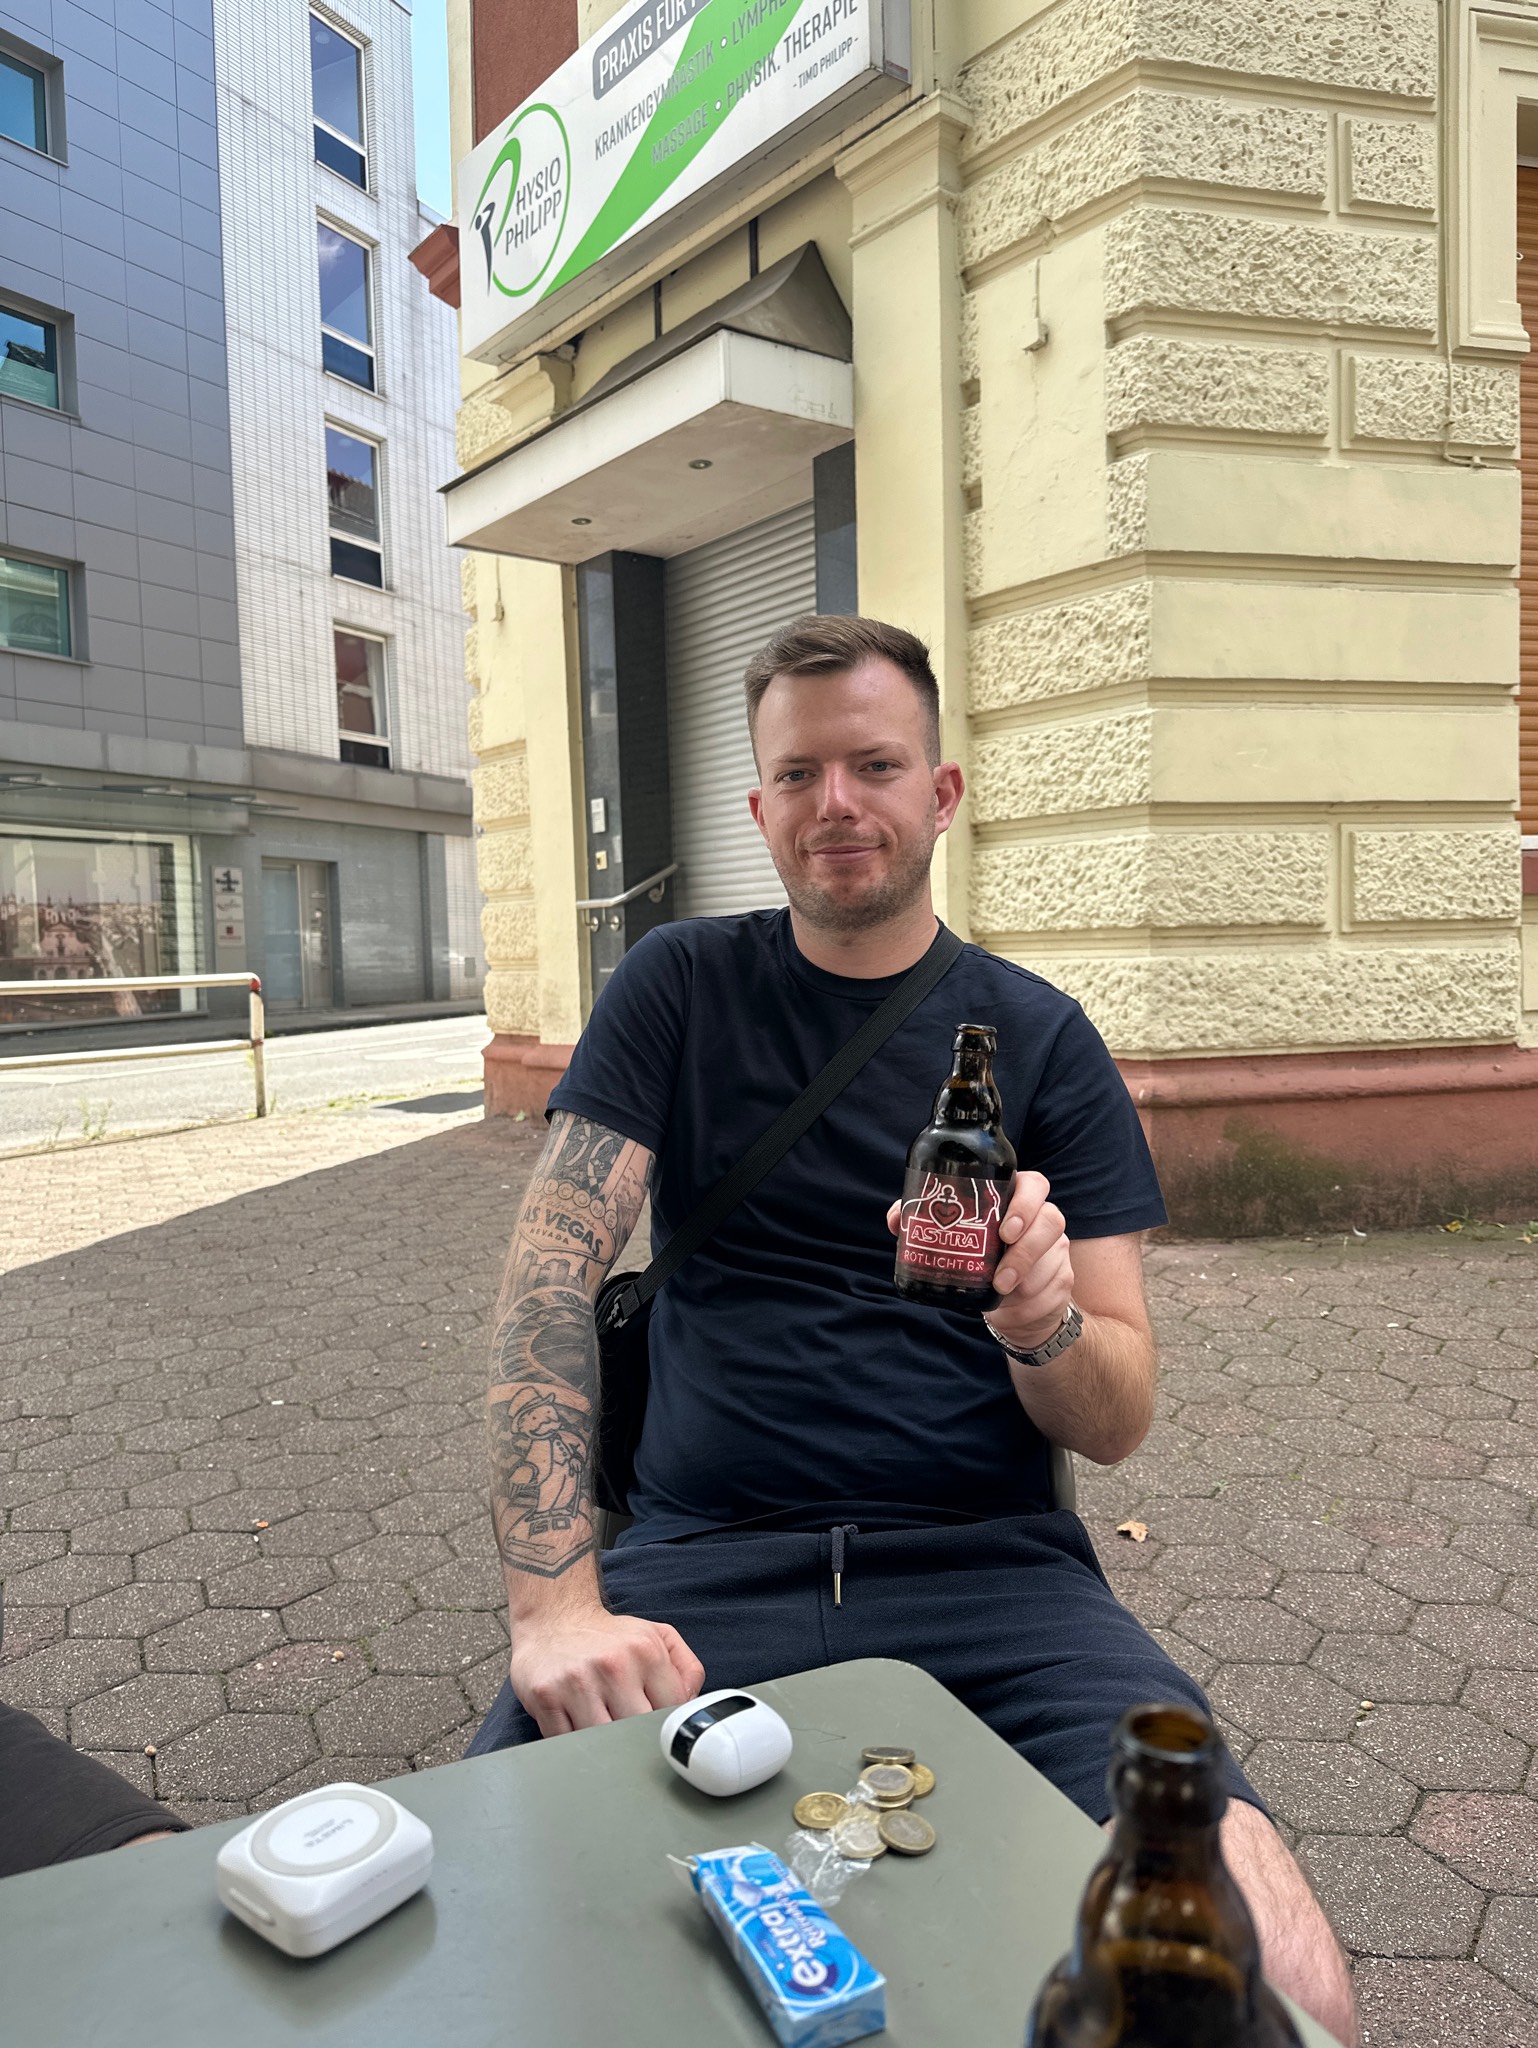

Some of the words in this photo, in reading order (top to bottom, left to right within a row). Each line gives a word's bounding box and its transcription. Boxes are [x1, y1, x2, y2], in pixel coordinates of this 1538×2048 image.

[594, 40, 715, 161] KRANKENGYMNASTIK
[732, 0, 788, 45] LYMPH
[600, 15, 653, 90] PRAXIS
[819, 37, 853, 70] PHILIPP
[652, 103, 709, 167] MASSAGE
[727, 48, 781, 108] PHYSIK.
[506, 189, 562, 256] PHILIPP
[521, 1205, 541, 1224] AS
[545, 1208, 604, 1257] VEGAS
[529, 1227, 569, 1245] NEVADA
[904, 1249, 964, 1270] ROTLICHT
[911, 1224, 979, 1249] ASTRA
[760, 1909, 829, 1987] extra
